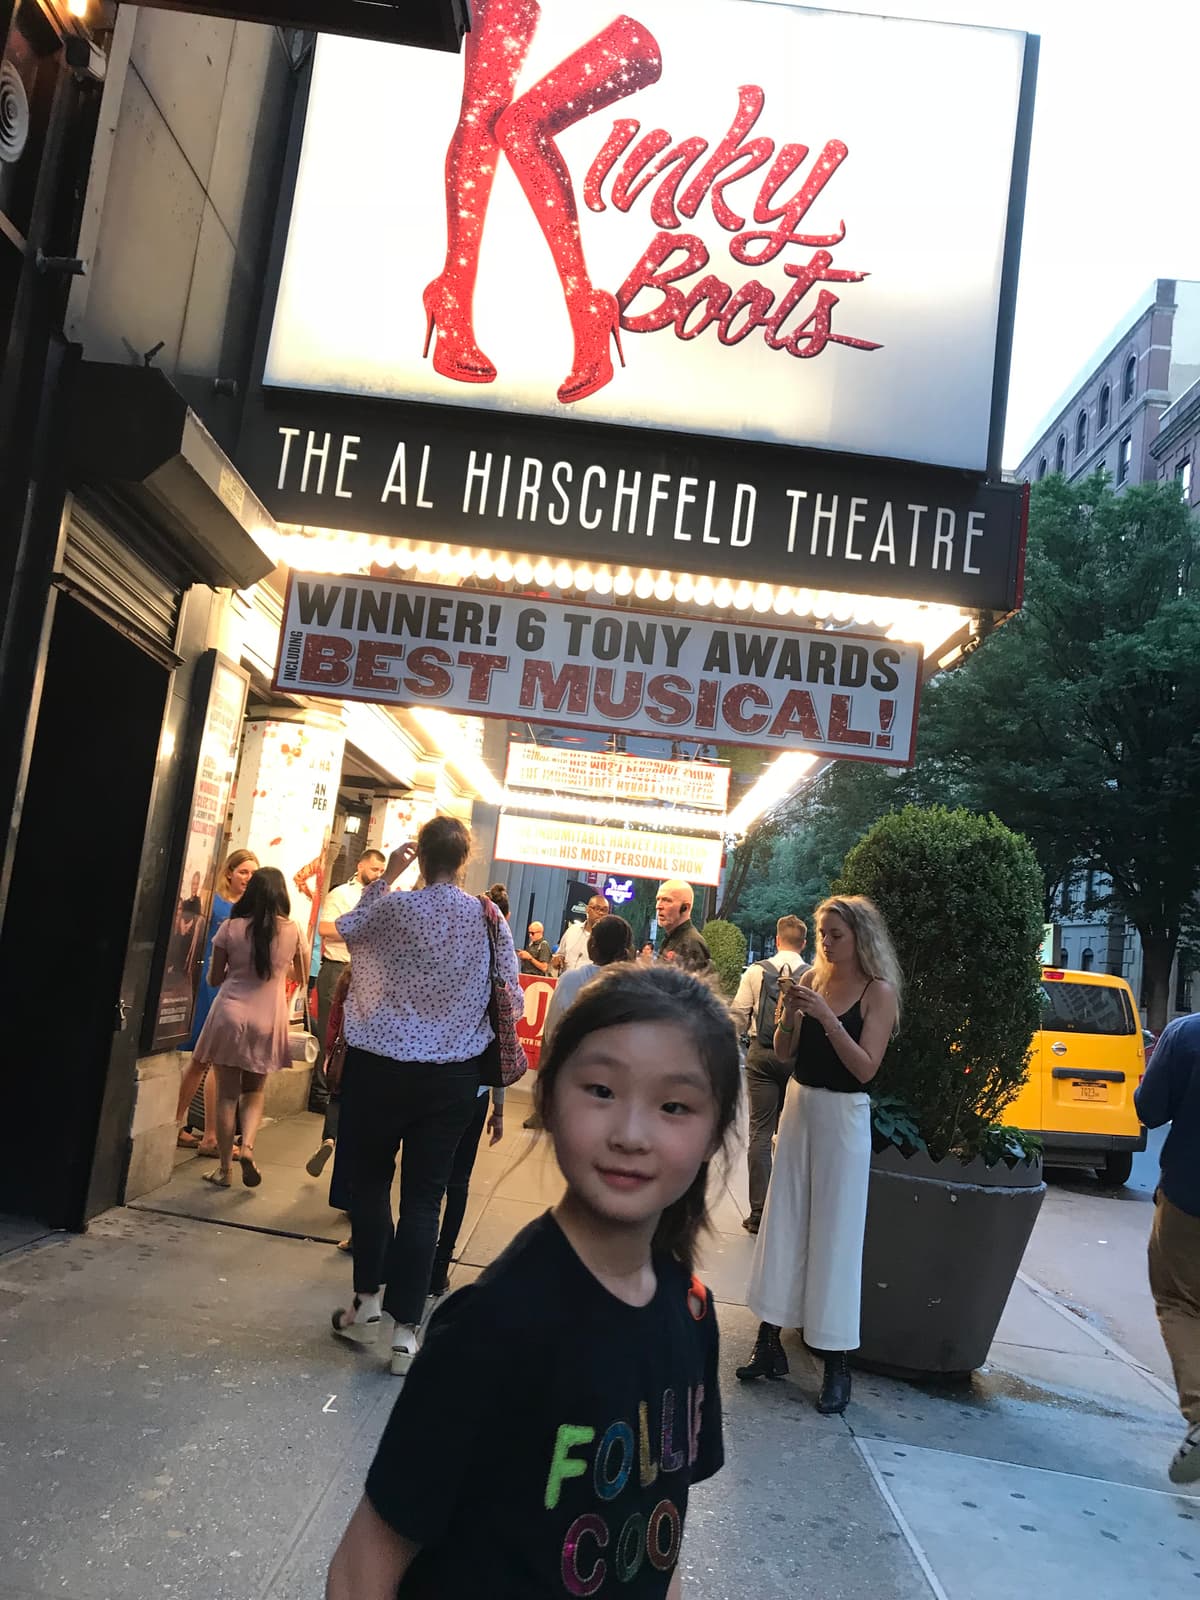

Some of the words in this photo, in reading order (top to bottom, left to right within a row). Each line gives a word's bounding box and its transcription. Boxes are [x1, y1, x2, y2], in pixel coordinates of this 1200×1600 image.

[617, 231, 885, 358] Boots
[278, 427, 361, 498] THE
[381, 441, 433, 509] AL
[462, 450, 757, 548] HIRSCHFELD
[786, 489, 986, 575] THEATRE
[283, 630, 304, 682] INCLUDING
[297, 581, 502, 646] WINNER!
[515, 608, 547, 652] 6
[563, 613, 692, 668] TONY
[703, 630, 901, 692] AWARDS
[299, 633, 510, 704] BEST
[518, 658, 897, 750] MUSICAL!
[559, 845, 578, 859] HIS
[581, 847, 612, 864] MOST
[614, 851, 668, 870] PERSONAL
